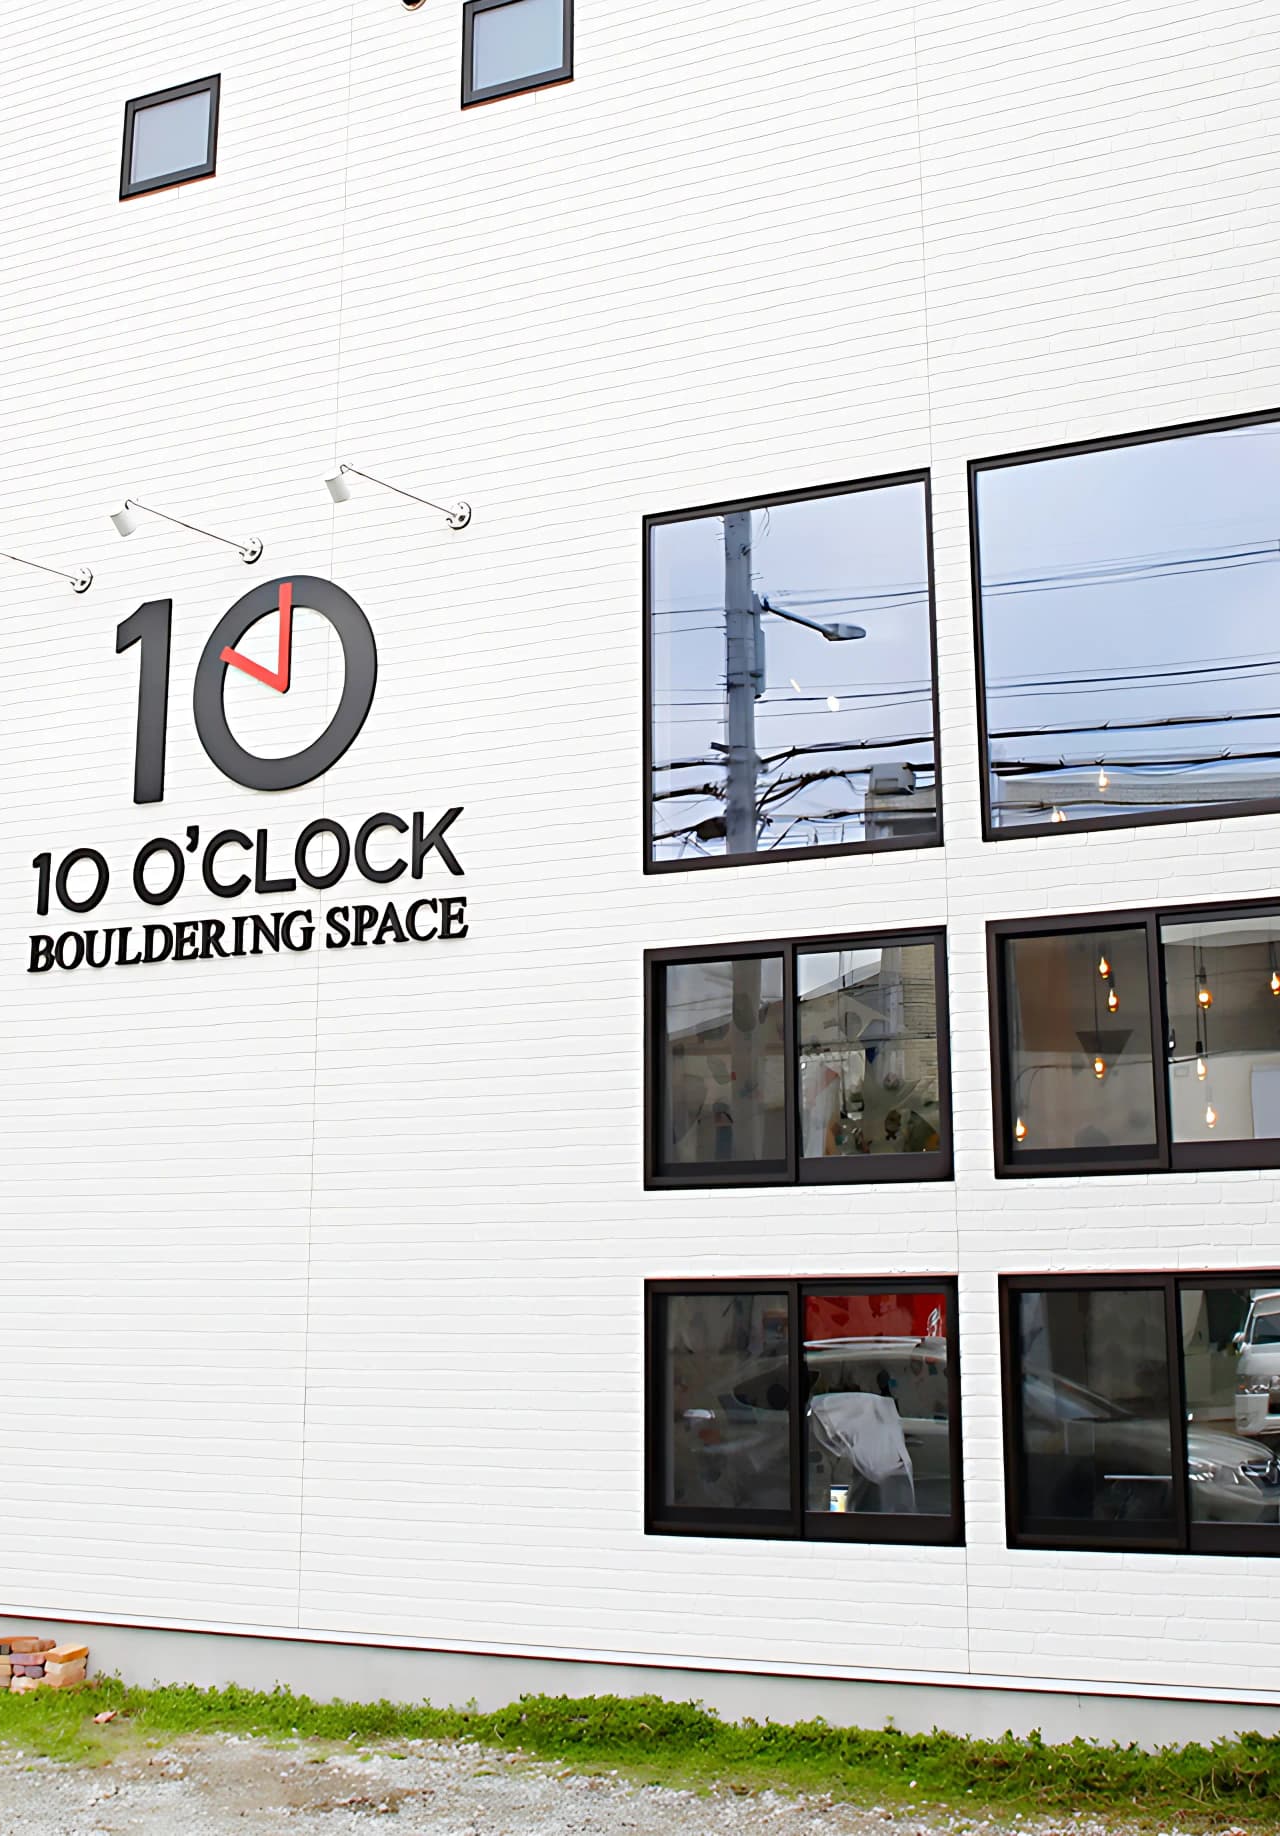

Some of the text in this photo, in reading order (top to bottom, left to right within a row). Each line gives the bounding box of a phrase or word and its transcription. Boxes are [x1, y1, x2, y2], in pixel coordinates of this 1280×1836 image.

[116, 574, 378, 804] 10
[32, 807, 465, 916] 10 O'CLOCK
[27, 896, 469, 973] BOULDERING SPACE
